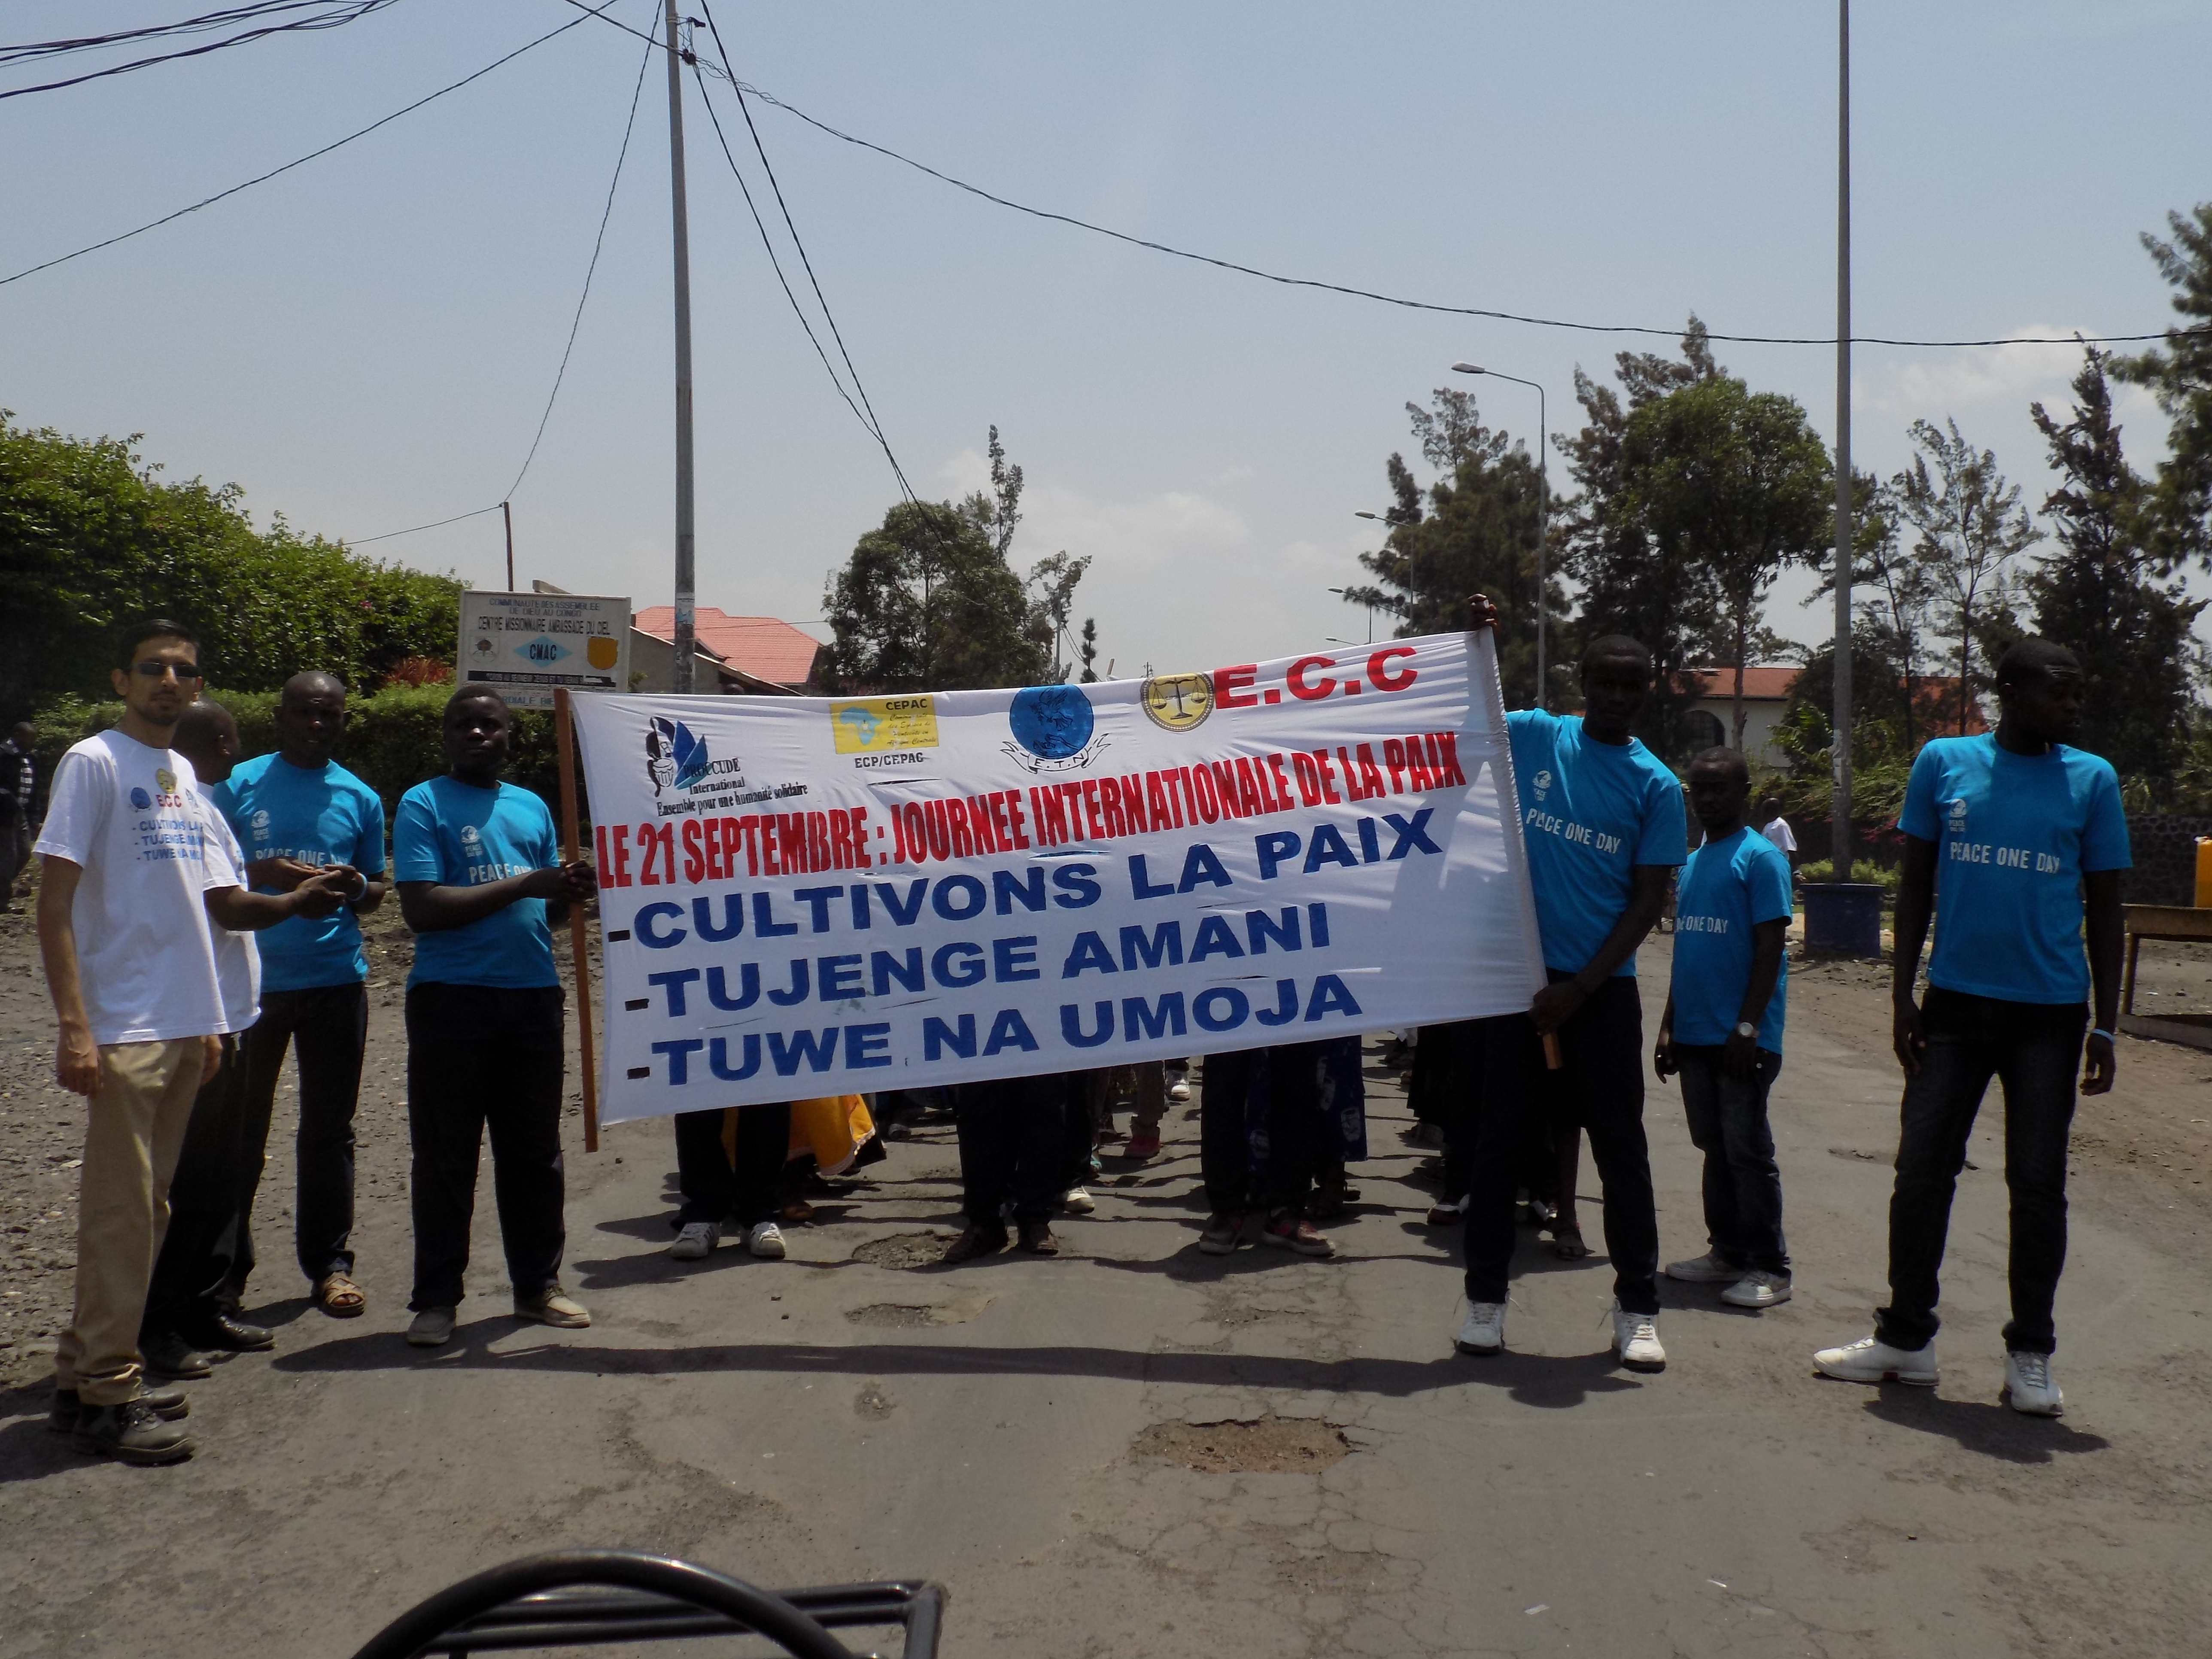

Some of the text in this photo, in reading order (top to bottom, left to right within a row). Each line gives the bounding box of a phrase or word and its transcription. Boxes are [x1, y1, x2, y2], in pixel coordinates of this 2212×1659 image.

[479, 616, 503, 631] CENTRE
[530, 644, 557, 660] CMAC
[886, 699, 927, 710] CEPAC
[854, 752, 924, 769] ECP/CEPAC
[690, 776, 745, 794] International
[657, 781, 808, 817] Ensemble pour une humanité solidaire
[596, 824, 632, 889] LE
[637, 821, 676, 886] 21
[681, 806, 872, 884] SEPTEMBRE
[890, 788, 1030, 864] JOURNEE
[1028, 752, 1296, 847] INTERNATIONALE
[1290, 749, 1341, 807] DE
[1337, 742, 1387, 802] LA
[1382, 731, 1466, 795] PAIX
[1565, 822, 1593, 845] ONE
[1595, 833, 1622, 854] DAY
[298, 849, 326, 868] ONE
[1128, 845, 1234, 901] LA
[1256, 809, 1444, 881] PAIX
[1950, 842, 2060, 874] PEACE ONE DAY
[468, 863, 511, 884] PEACE
[1686, 916, 1705, 931] ONE
[1707, 917, 1728, 934] DAY
[1060, 903, 1331, 980] AMANI
[922, 1010, 1039, 1062] NA
[1059, 974, 1363, 1048] UMOJA
